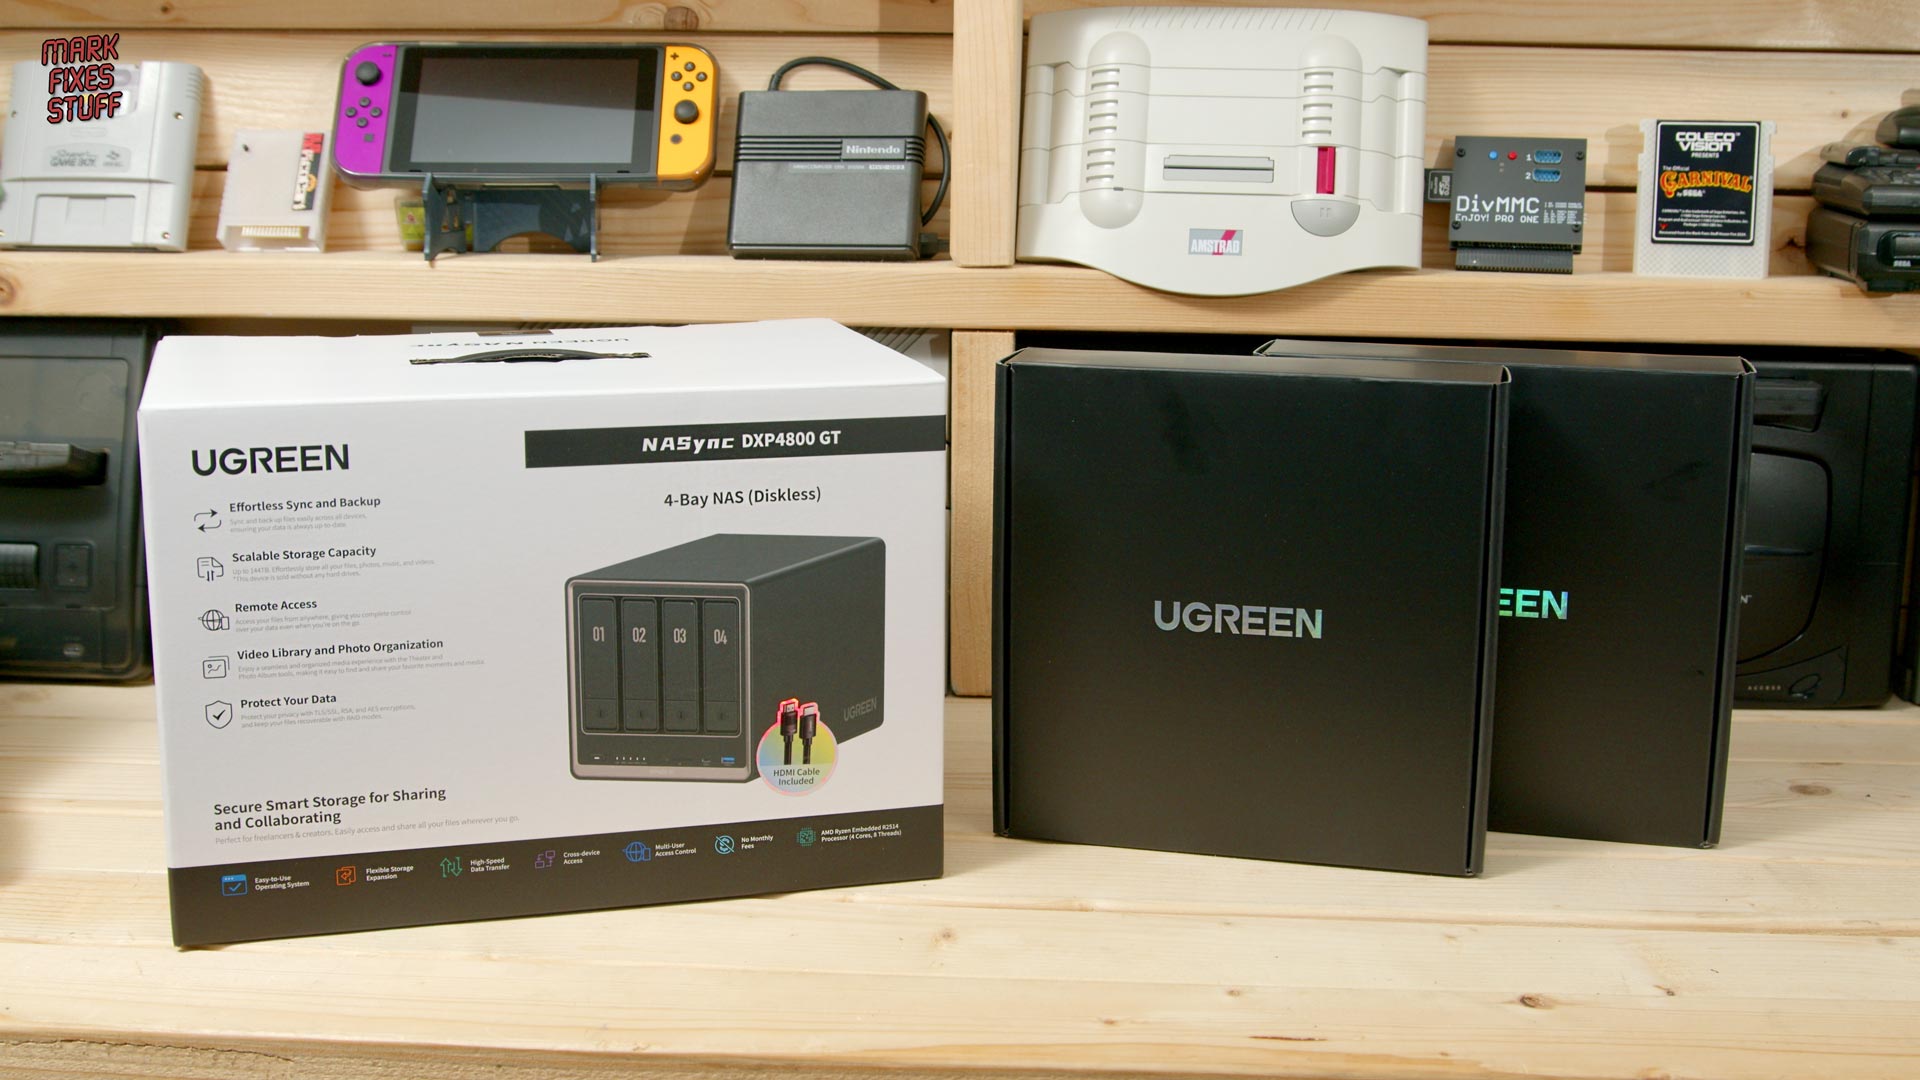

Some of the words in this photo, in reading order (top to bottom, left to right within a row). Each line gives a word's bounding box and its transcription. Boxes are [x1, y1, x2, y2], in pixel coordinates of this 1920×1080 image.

[846, 145, 900, 154] Nintendo
[1679, 142, 1732, 152] VISION
[1525, 172, 1531, 180] 2
[1660, 170, 1752, 198] CARNIVAL
[1456, 194, 1540, 214] DivMMC
[1455, 214, 1490, 222] EnJOY!
[1494, 214, 1514, 222] PRO
[1520, 216, 1540, 224] ONE
[1190, 239, 1240, 254] AMSTRAD
[642, 436, 735, 454] NASync
[742, 431, 816, 448] DXP4800
[818, 430, 842, 445] GT
[191, 443, 350, 477] UGREEN
[664, 491, 708, 508] 4-Bay
[713, 490, 744, 504] NAS
[748, 486, 822, 506] (Diskless)
[230, 501, 284, 512] Effortless
[286, 500, 313, 512] Sync
[316, 498, 337, 509] and
[340, 496, 381, 508] Backup
[232, 552, 280, 562] Scalable
[282, 550, 326, 562] Storage
[328, 546, 376, 558] Capacity
[235, 602, 278, 612] Remote
[281, 600, 318, 610] Access
[1498, 587, 1568, 620] EEN
[1154, 600, 1323, 639] UGREEN
[592, 626, 605, 642] 01
[632, 627, 646, 644] 02
[674, 628, 686, 644] 03
[714, 629, 728, 645] 04
[237, 650, 269, 660] Video
[272, 648, 312, 658] Library
[314, 645, 335, 655] and
[338, 644, 370, 654] Photo
[373, 639, 444, 653] Organization
[240, 697, 282, 708] Protect
[283, 696, 308, 706] Your
[312, 694, 337, 704] Data
[844, 696, 878, 722] UGREEN
[773, 768, 795, 777] HDMI
[797, 768, 820, 776] Cable
[778, 777, 814, 786] Included
[214, 802, 262, 815] Secure
[266, 798, 309, 811] Smart
[312, 796, 366, 808] Storage
[369, 792, 390, 804] for
[392, 788, 447, 802] Sharing
[214, 818, 242, 831] and
[245, 811, 342, 828] Collaborating
[216, 835, 241, 844] Perfect
[242, 834, 252, 842] for
[254, 832, 294, 841] freelancers
[302, 828, 332, 838] creators.
[335, 826, 354, 837] Easily
[382, 823, 395, 831] and
[397, 822, 416, 830] share
[428, 821, 443, 830] your
[445, 818, 460, 827] files
[462, 816, 493, 825] wherever
[494, 816, 507, 825] you
[509, 815, 520, 824] go.
[835, 828, 851, 836] Ryzen
[852, 826, 881, 834] Embedded
[849, 833, 854, 841] (4
[855, 832, 872, 840] Cores,
[878, 829, 902, 838] Threads)
[750, 835, 774, 844] Monthly
[656, 842, 685, 850] Multi-User
[676, 848, 696, 856] Control
[564, 850, 600, 858] Cross-device
[470, 857, 505, 866] High-Speed
[390, 865, 414, 873] Storage
[486, 864, 510, 872] Transfer
[254, 875, 292, 885] Easy-to-Use
[366, 874, 398, 882] Expansion
[255, 882, 286, 892] Operating
[286, 880, 310, 889] System
